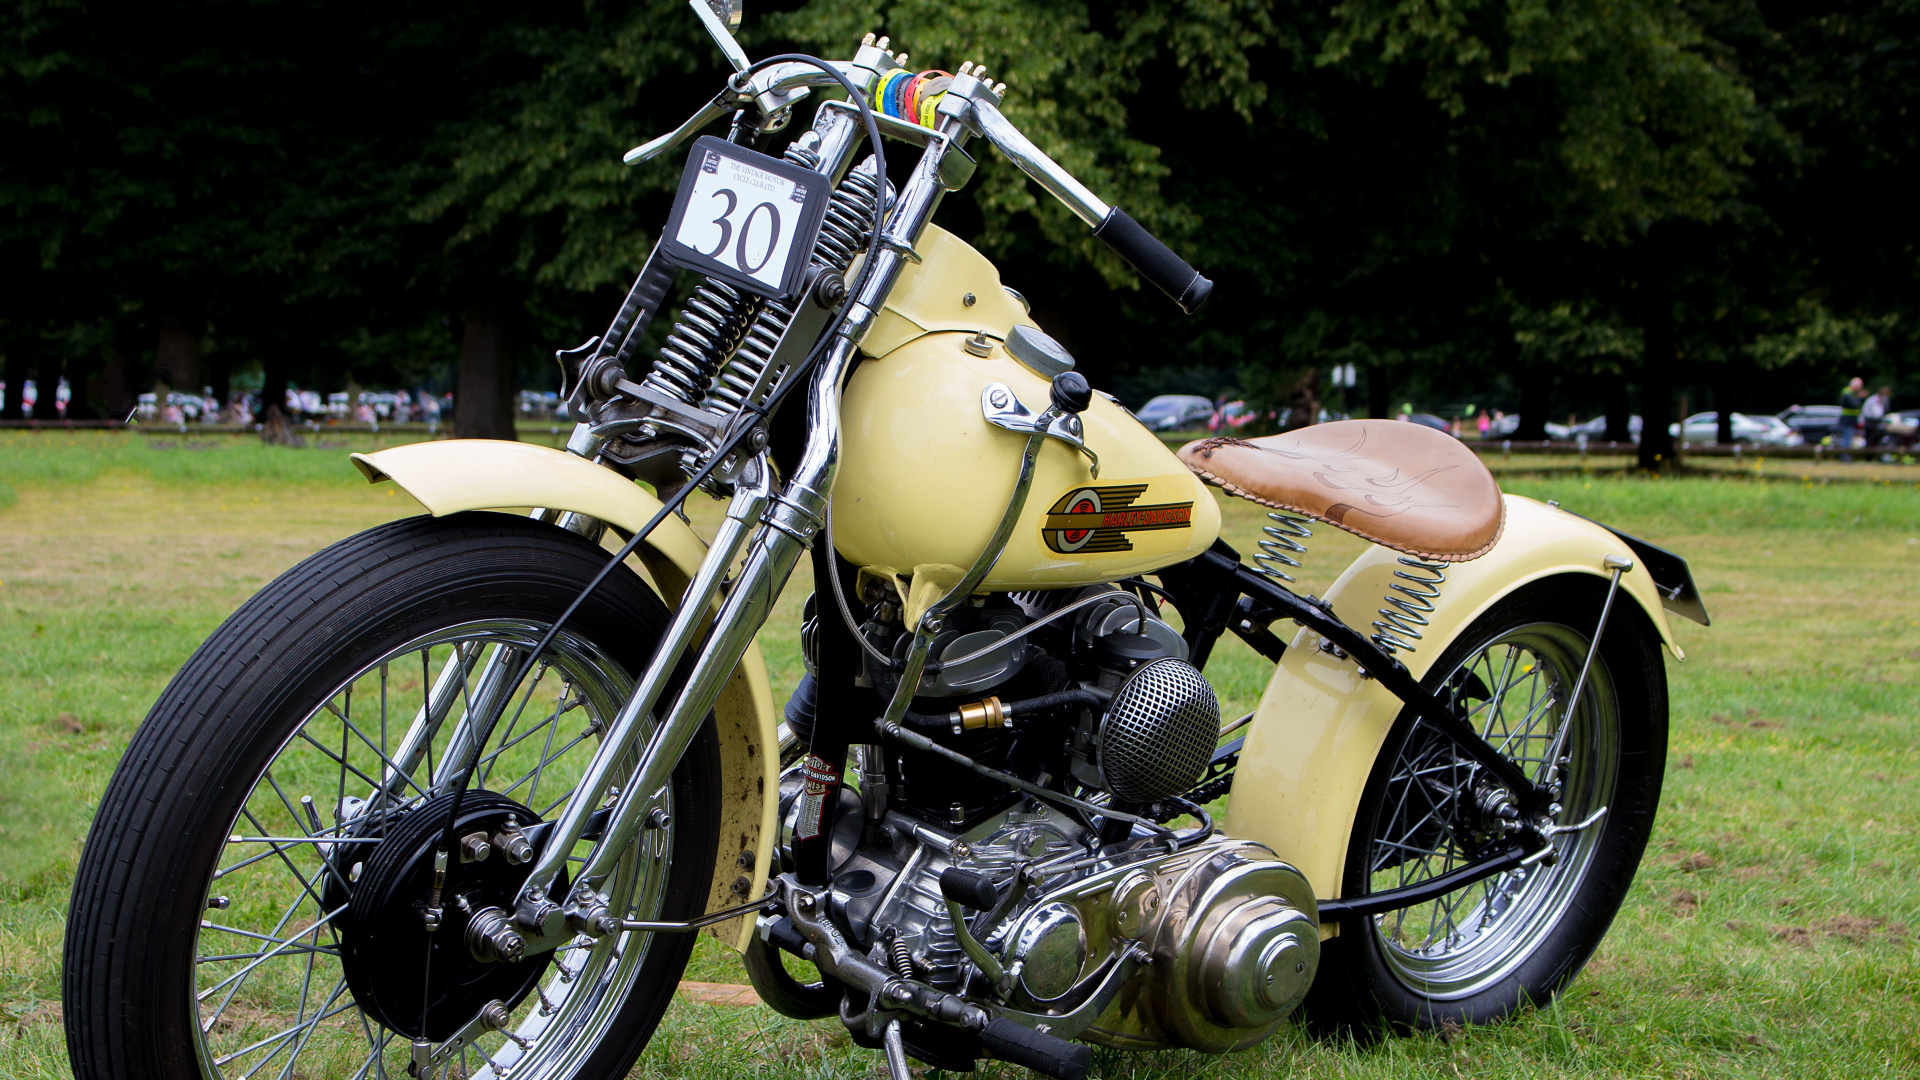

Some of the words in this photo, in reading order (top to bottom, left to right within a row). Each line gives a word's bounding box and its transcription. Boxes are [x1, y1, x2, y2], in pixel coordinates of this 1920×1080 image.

[730, 162, 741, 172] THE
[741, 166, 765, 180] VINTAGE
[764, 174, 786, 187] MOTOR
[733, 173, 750, 184] CYCLE
[749, 178, 765, 189] CLUB
[693, 188, 781, 275] 30
[1102, 507, 1191, 527] HARLEY-DAVIDSON
